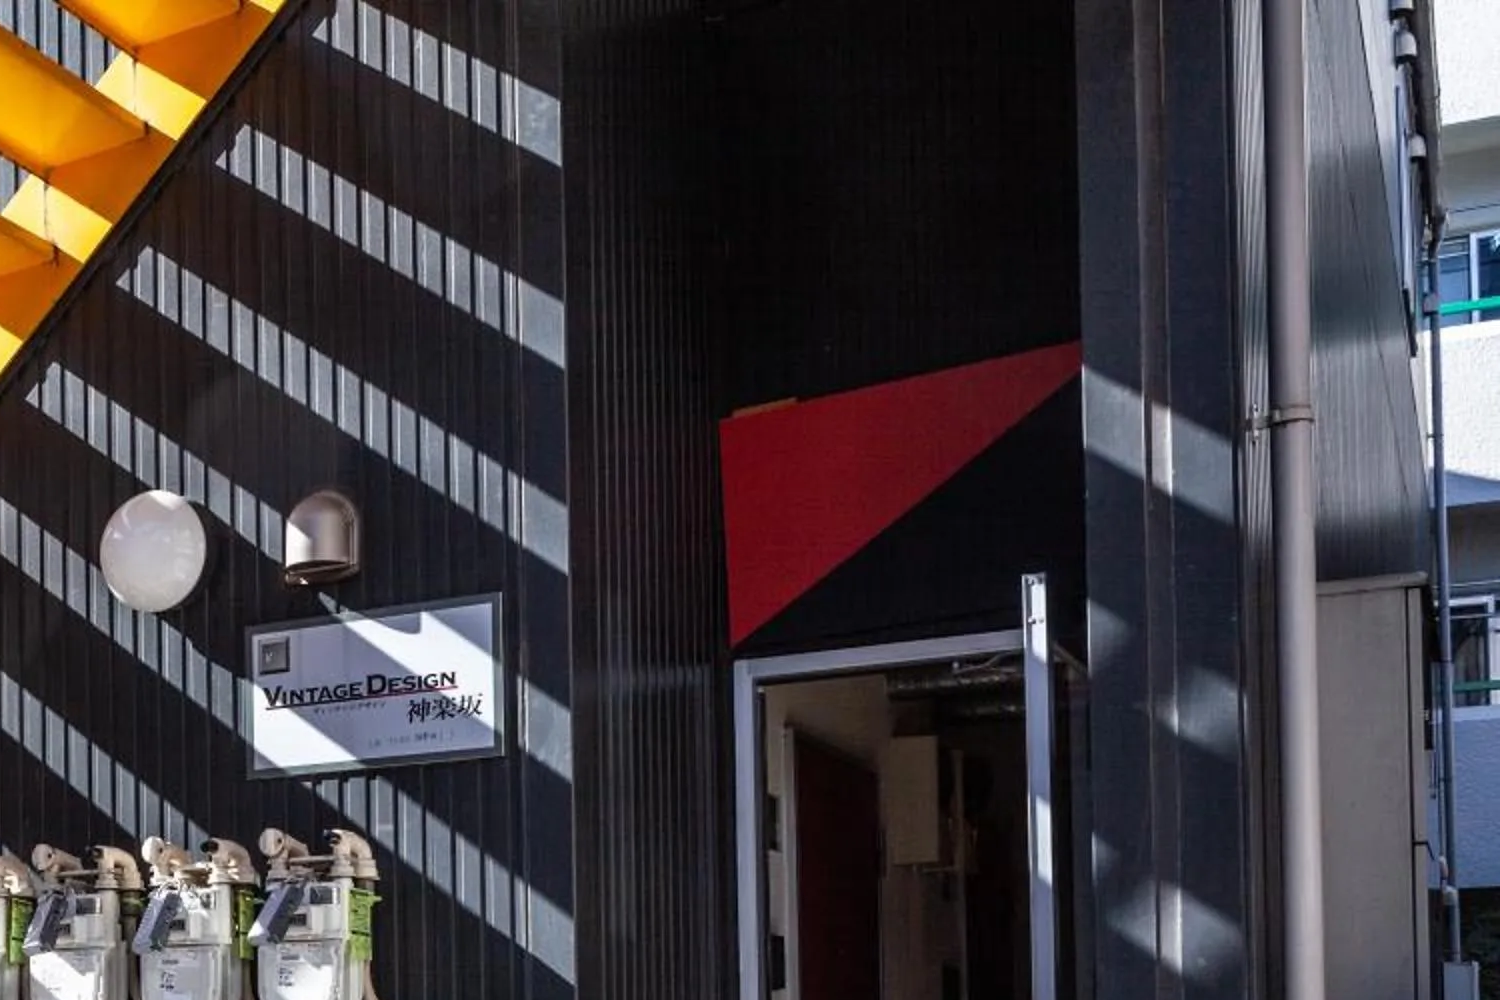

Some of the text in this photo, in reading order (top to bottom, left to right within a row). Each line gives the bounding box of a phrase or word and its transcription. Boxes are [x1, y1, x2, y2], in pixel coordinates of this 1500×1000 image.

[262, 671, 457, 706] VINTAGE DESIGN
[406, 693, 483, 724] 神楽坂
